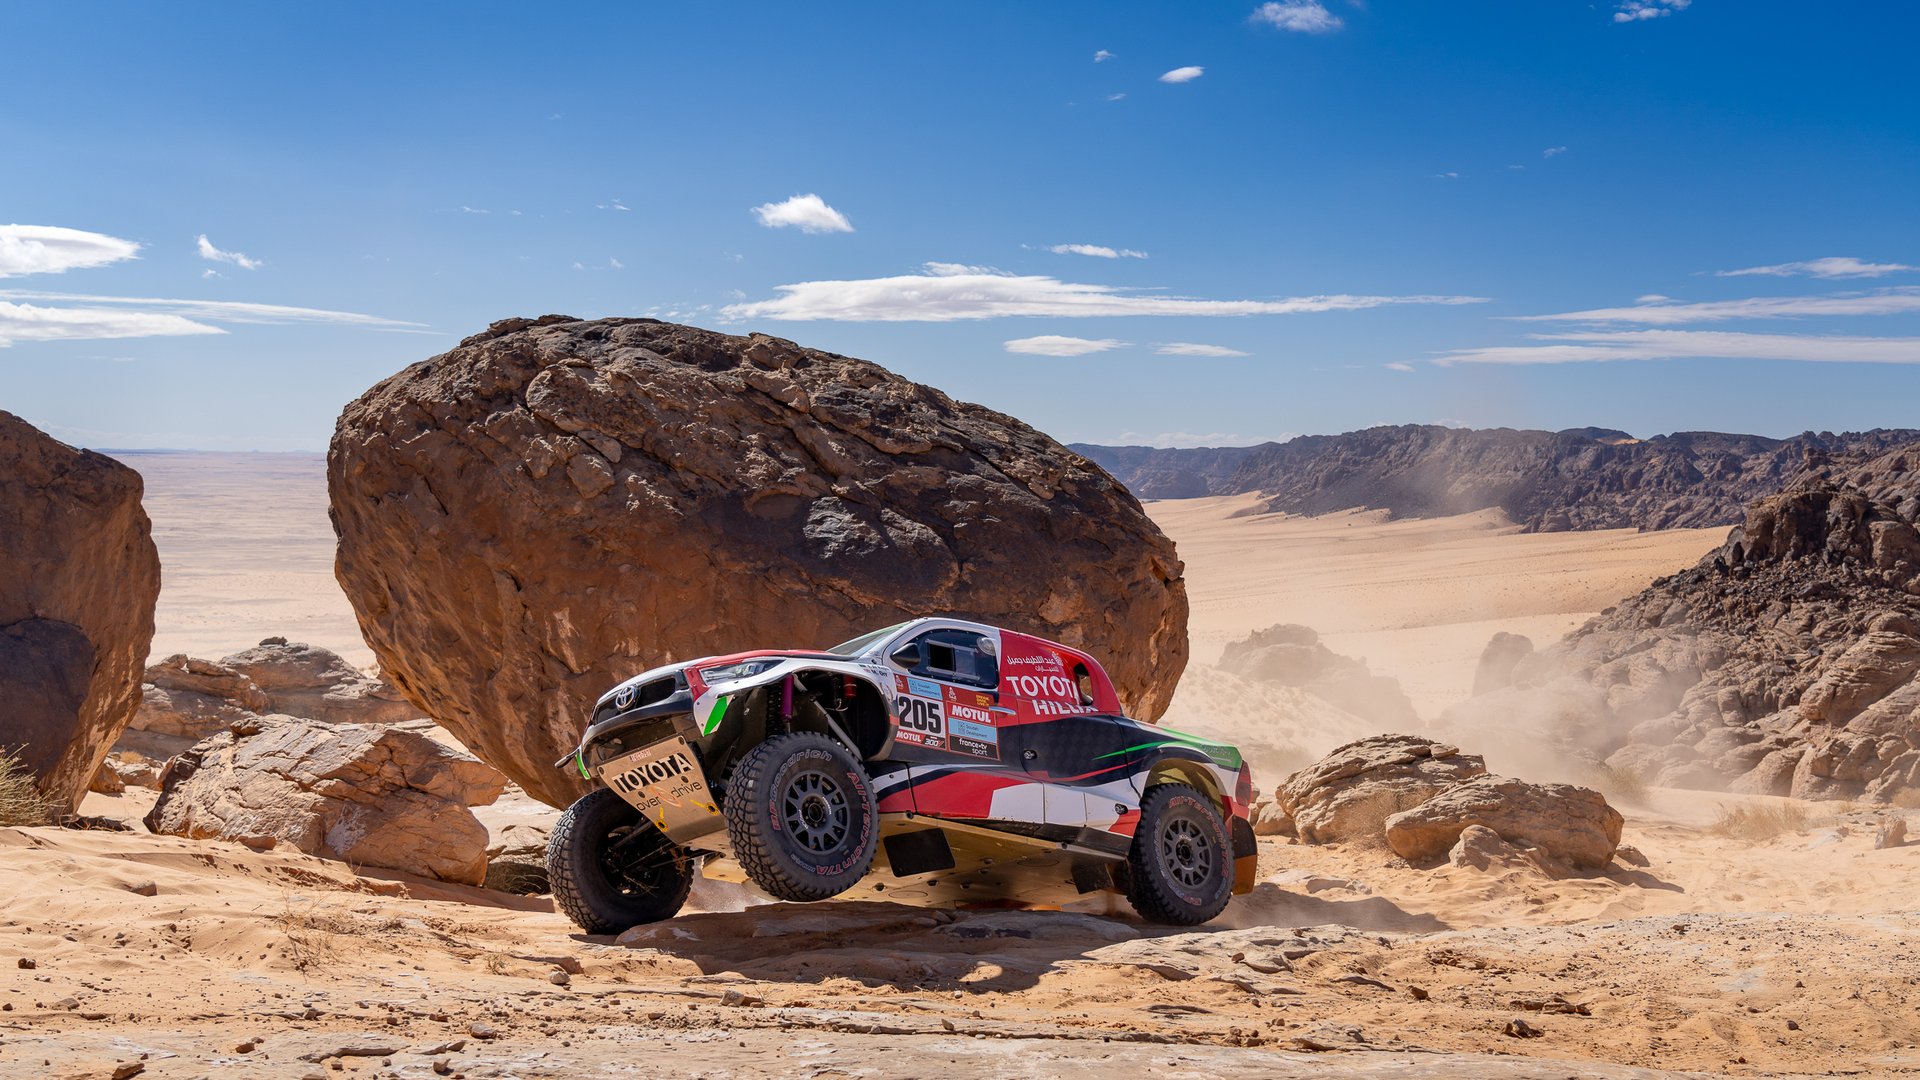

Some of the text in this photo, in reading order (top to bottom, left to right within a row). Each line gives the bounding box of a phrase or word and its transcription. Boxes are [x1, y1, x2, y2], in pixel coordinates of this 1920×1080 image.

[898, 696, 942, 734] 205
[951, 704, 992, 723] MOTUL
[896, 730, 922, 742] MOTUL
[971, 748, 988, 757] sport
[611, 752, 695, 794] TOYOTA
[636, 781, 703, 811] over drive
